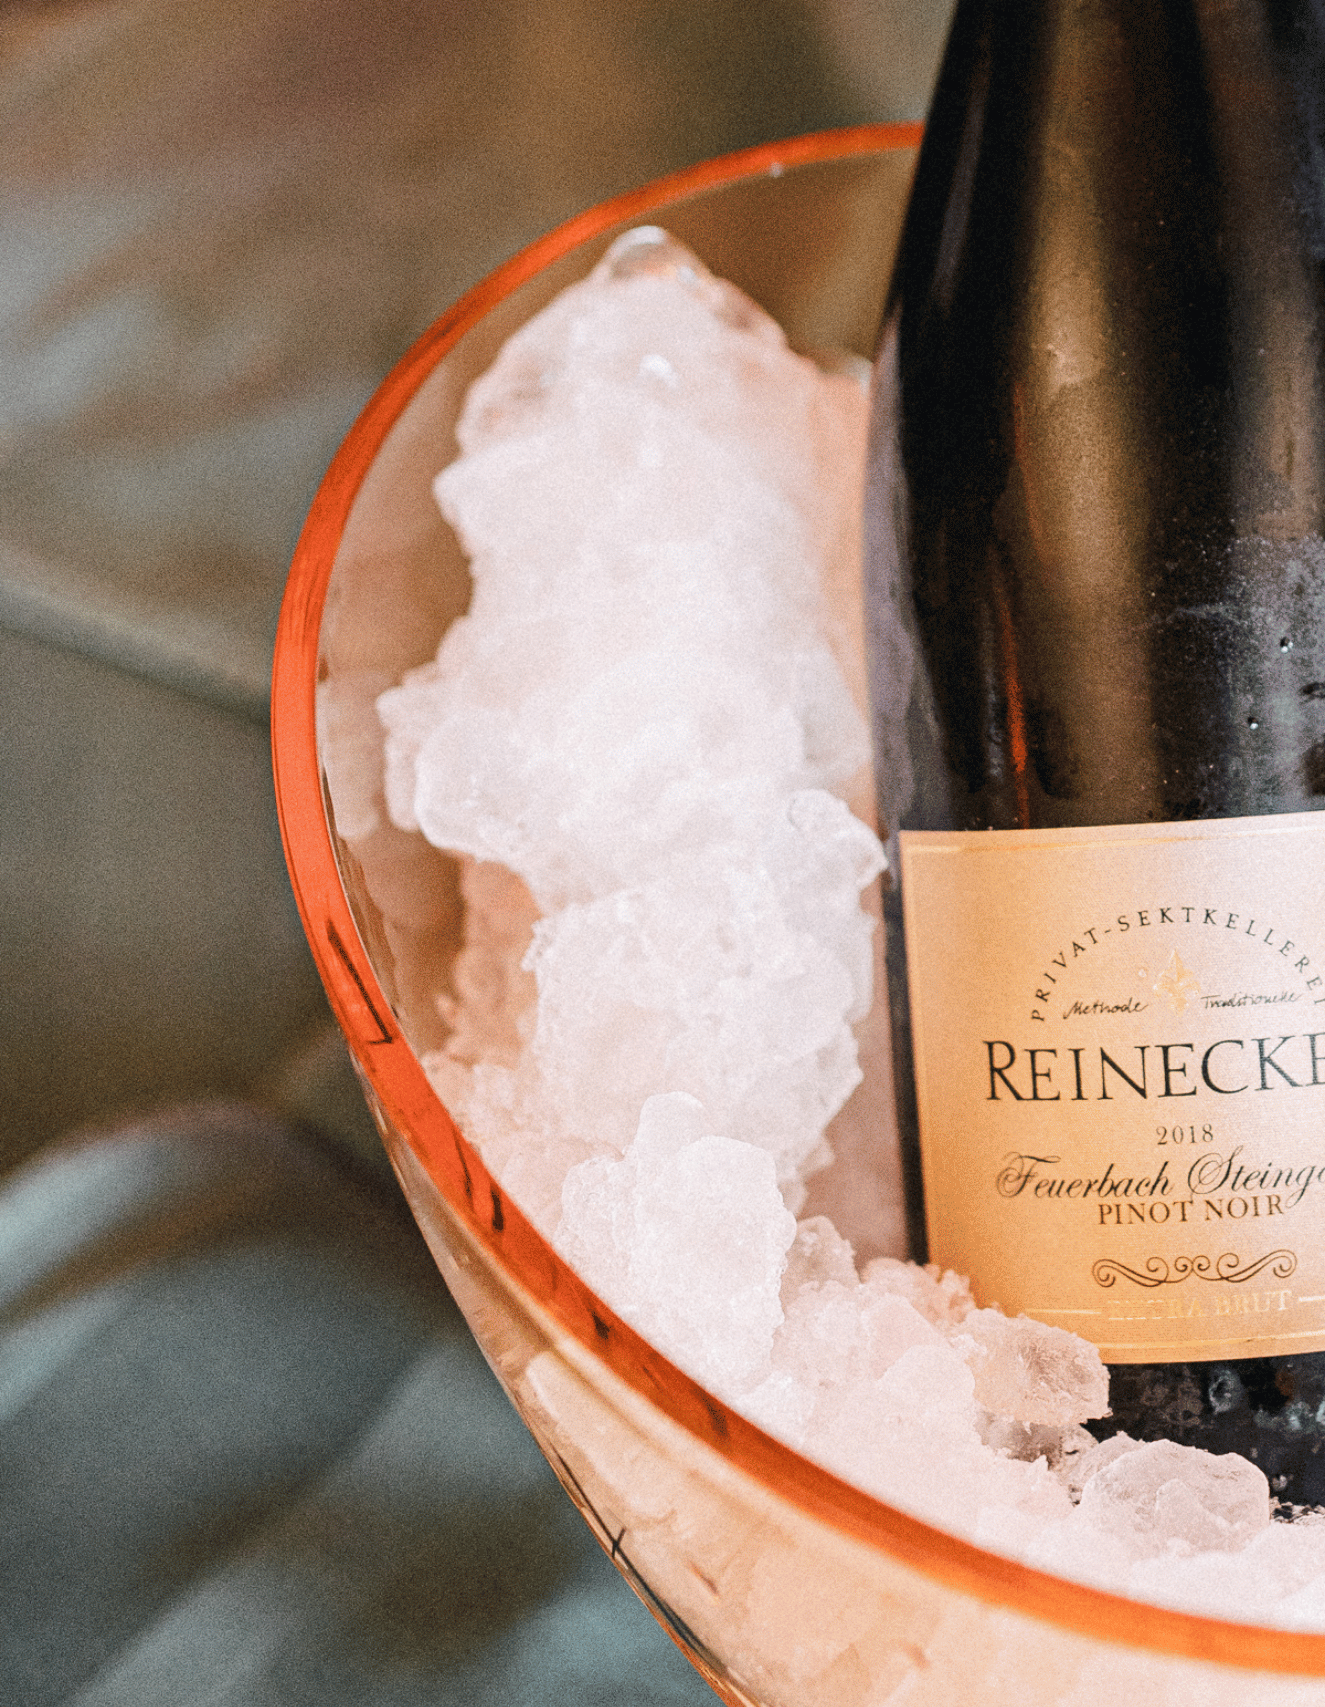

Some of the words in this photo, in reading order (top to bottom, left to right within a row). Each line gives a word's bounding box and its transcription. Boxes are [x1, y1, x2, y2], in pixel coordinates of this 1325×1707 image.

[1062, 996, 1149, 1020] Methode
[1155, 1123, 1215, 1146] 2018
[995, 1151, 1174, 1199] Feuerbach
[1098, 1200, 1193, 1226] PINOT
[1204, 1194, 1285, 1221] NOIR
[1214, 1289, 1293, 1317] BRUT
